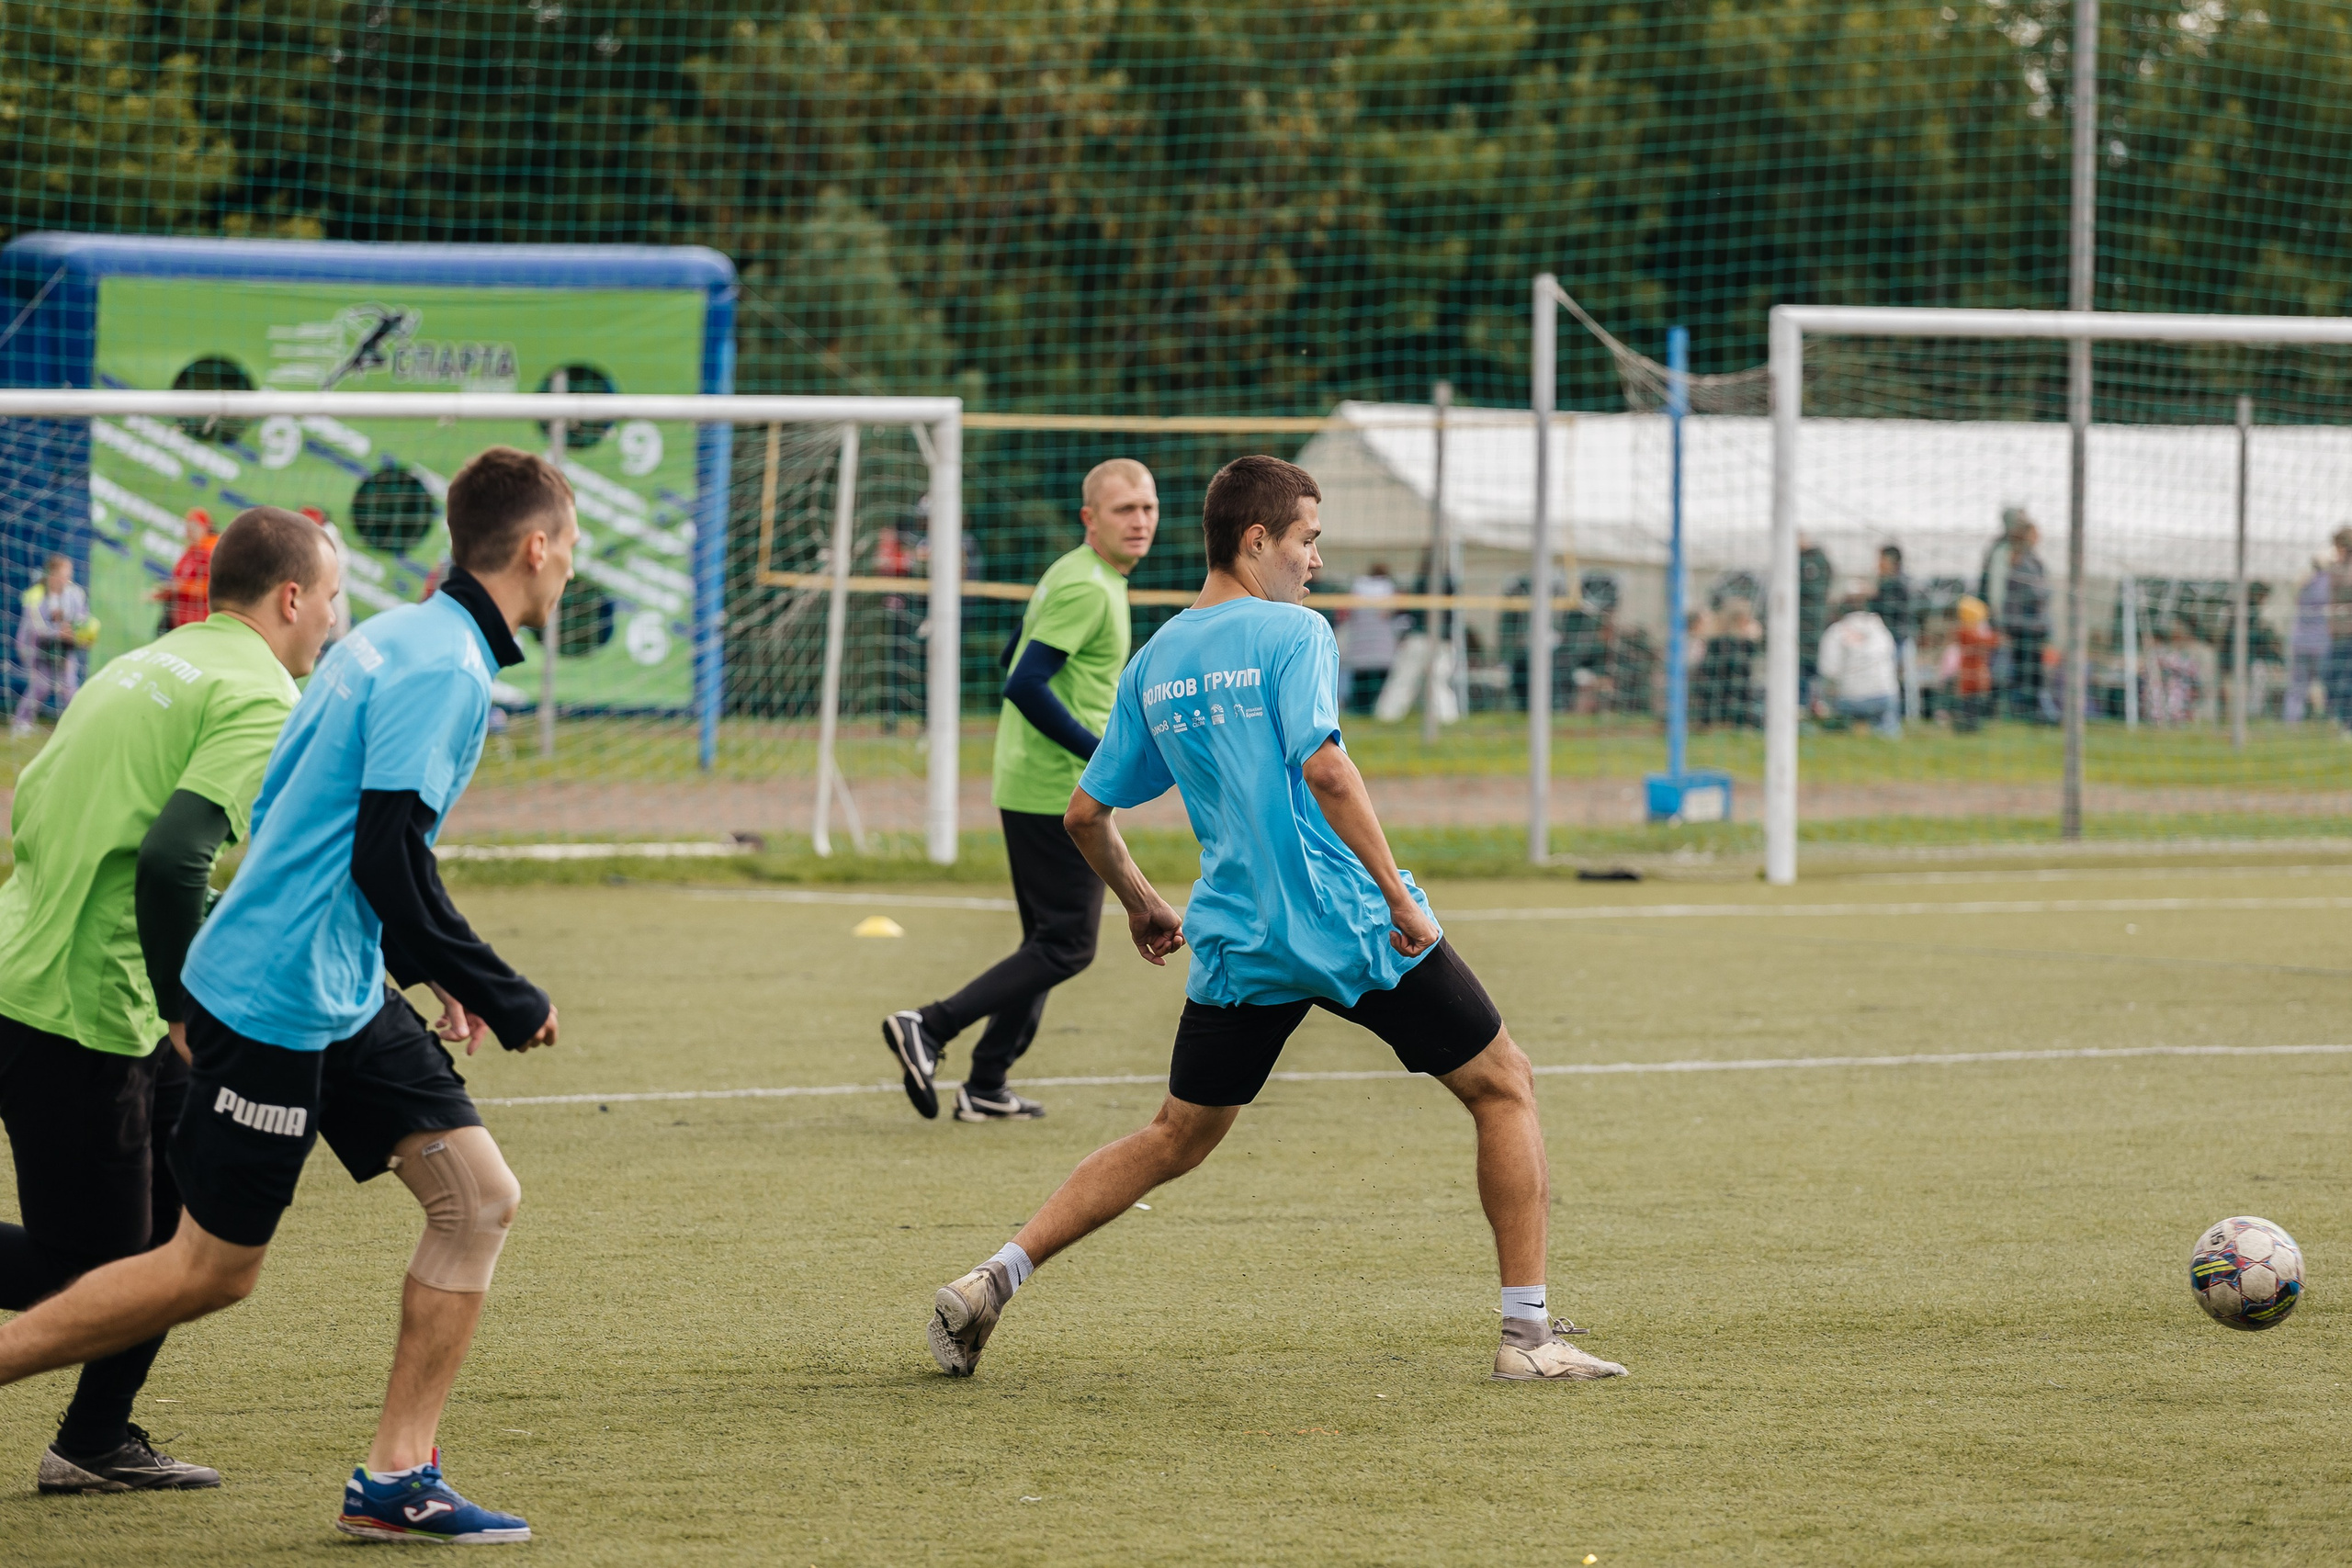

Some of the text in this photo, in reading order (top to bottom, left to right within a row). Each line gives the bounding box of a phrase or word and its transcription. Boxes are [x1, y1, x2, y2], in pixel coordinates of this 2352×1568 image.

[259, 414, 302, 470] 9
[618, 419, 664, 477] 9
[626, 609, 671, 666] 6
[1143, 668, 1261, 710] ВОЛКОВ ГРУПП
[213, 1086, 308, 1137] PUMA
